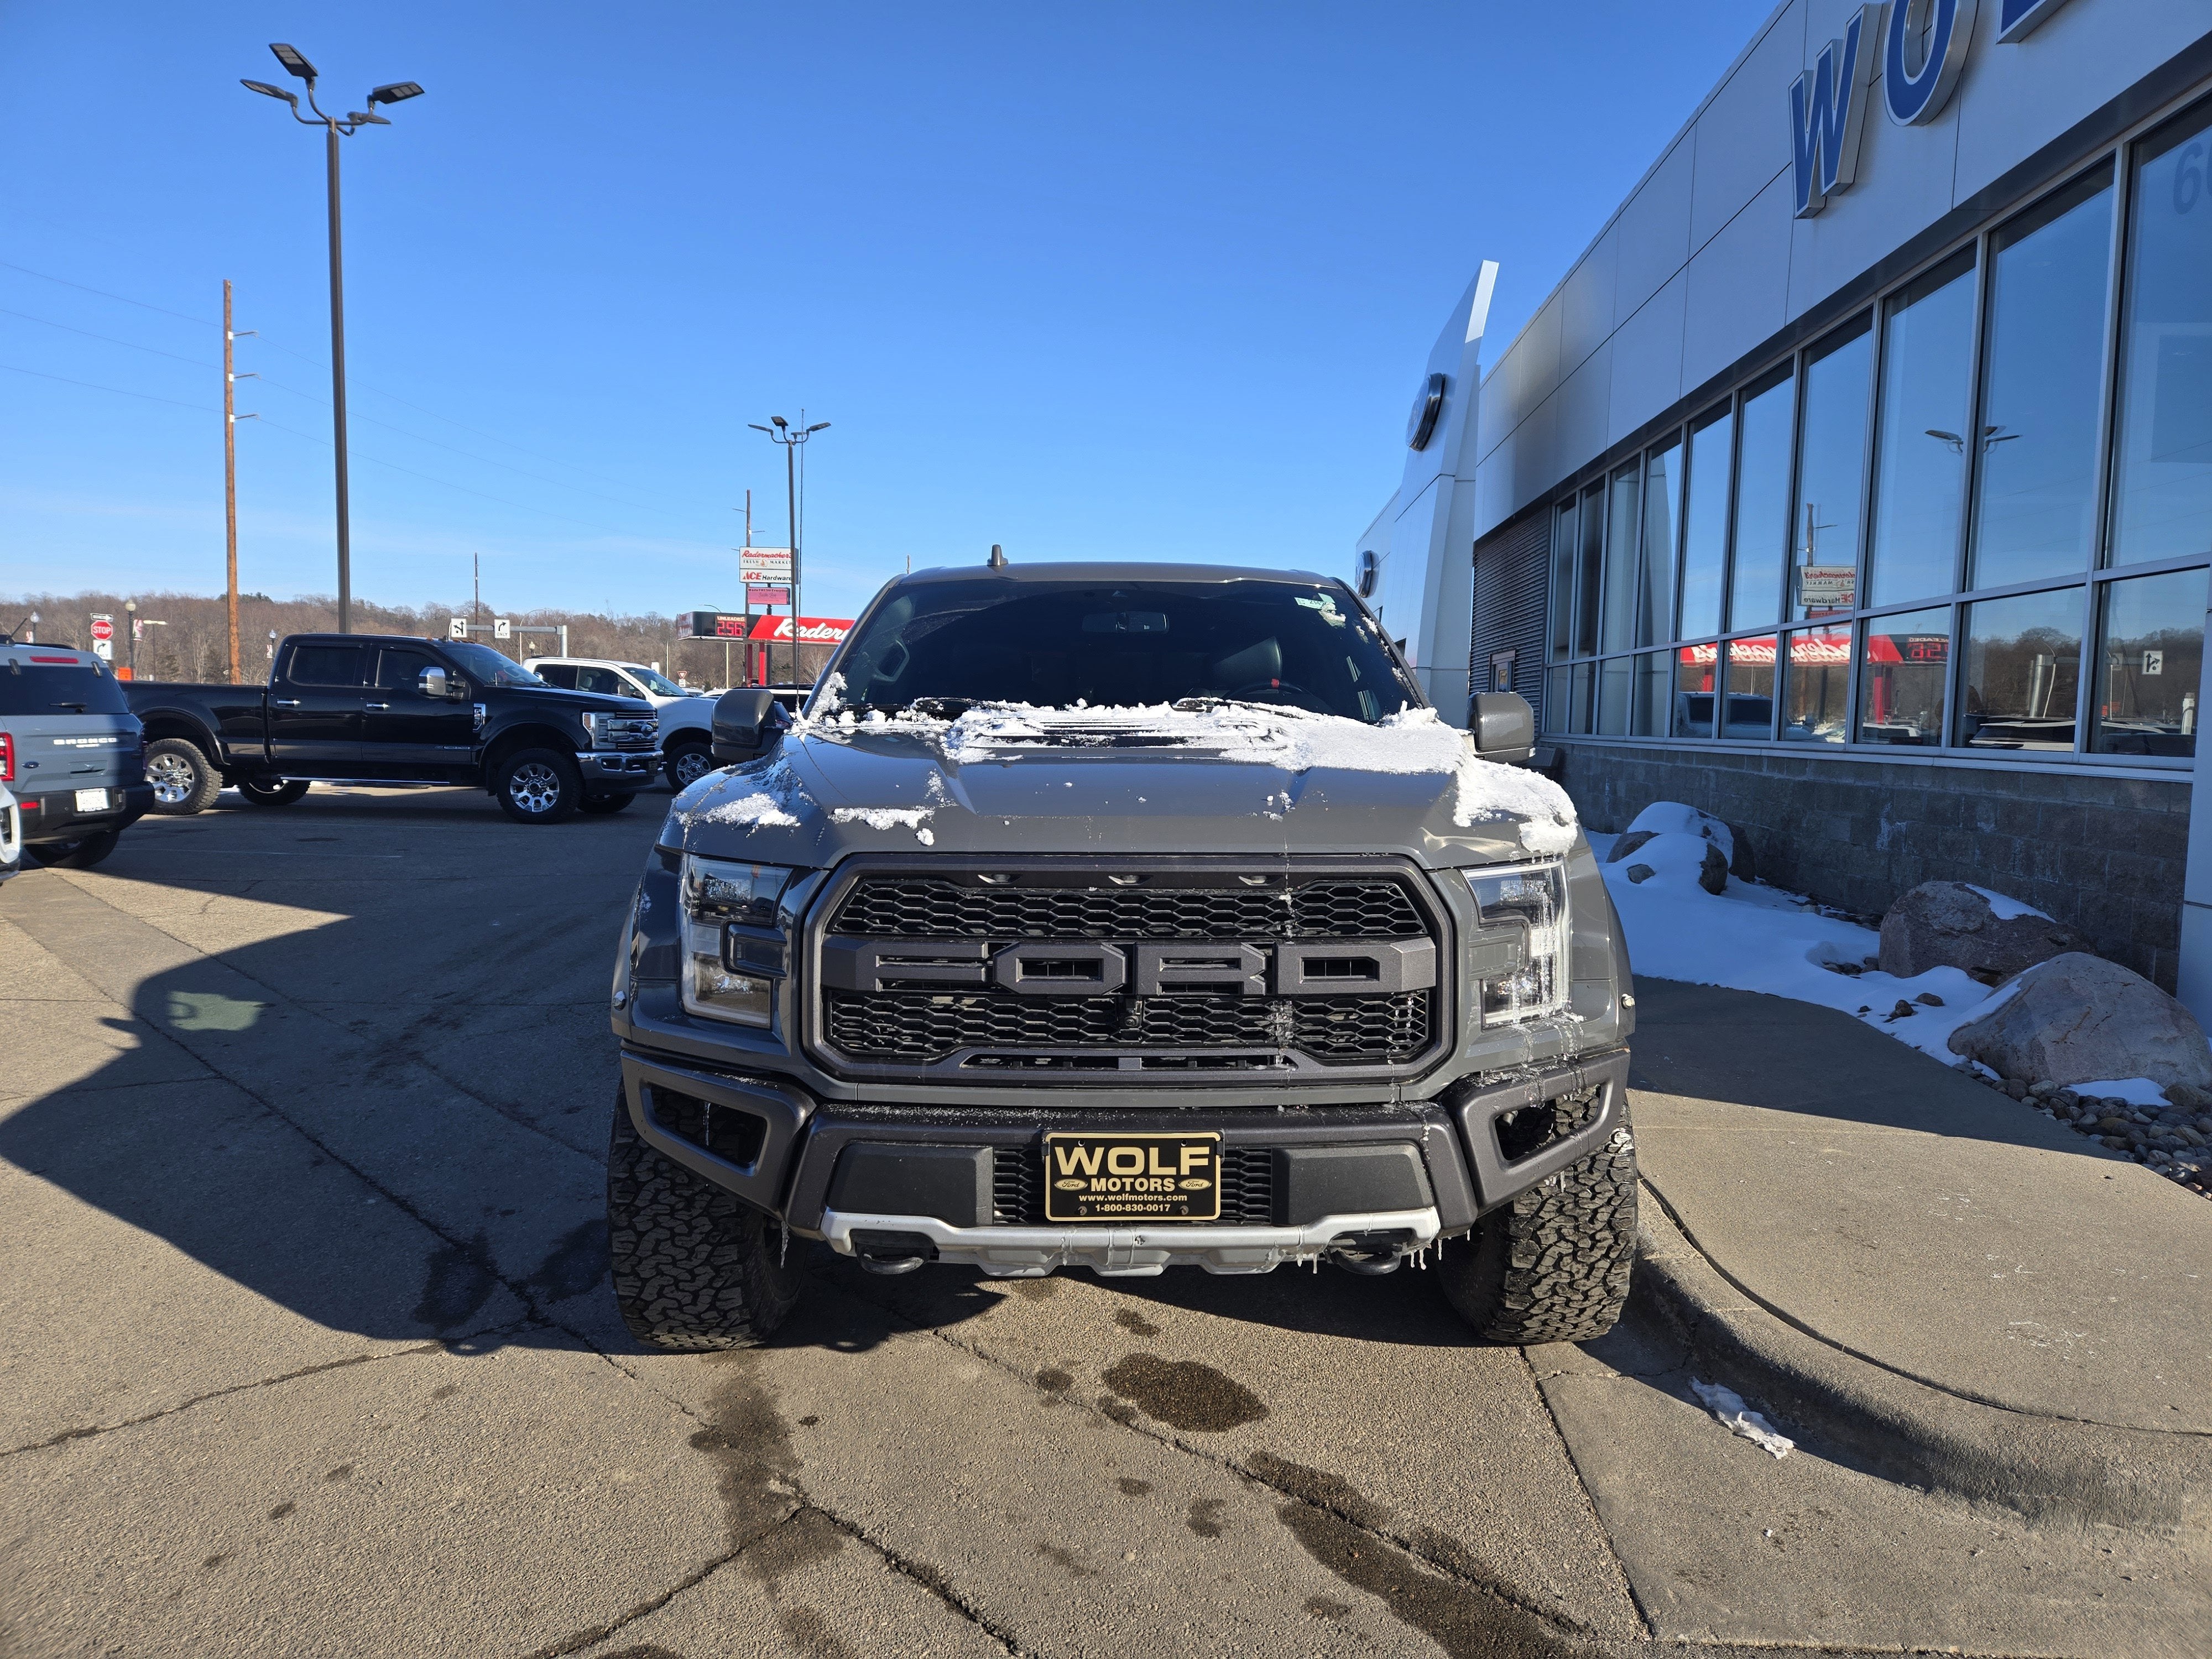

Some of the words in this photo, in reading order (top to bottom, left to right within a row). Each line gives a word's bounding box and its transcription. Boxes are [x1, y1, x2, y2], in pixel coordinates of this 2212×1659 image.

[1788, 0, 2068, 219] WO
[2173, 141, 2212, 216] 6
[743, 571, 762, 580] ACE
[93, 626, 111, 634] STOP
[822, 936, 1436, 996] FORD
[1055, 1146, 1210, 1175] WOLF
[1091, 1177, 1175, 1192] MOTORS
